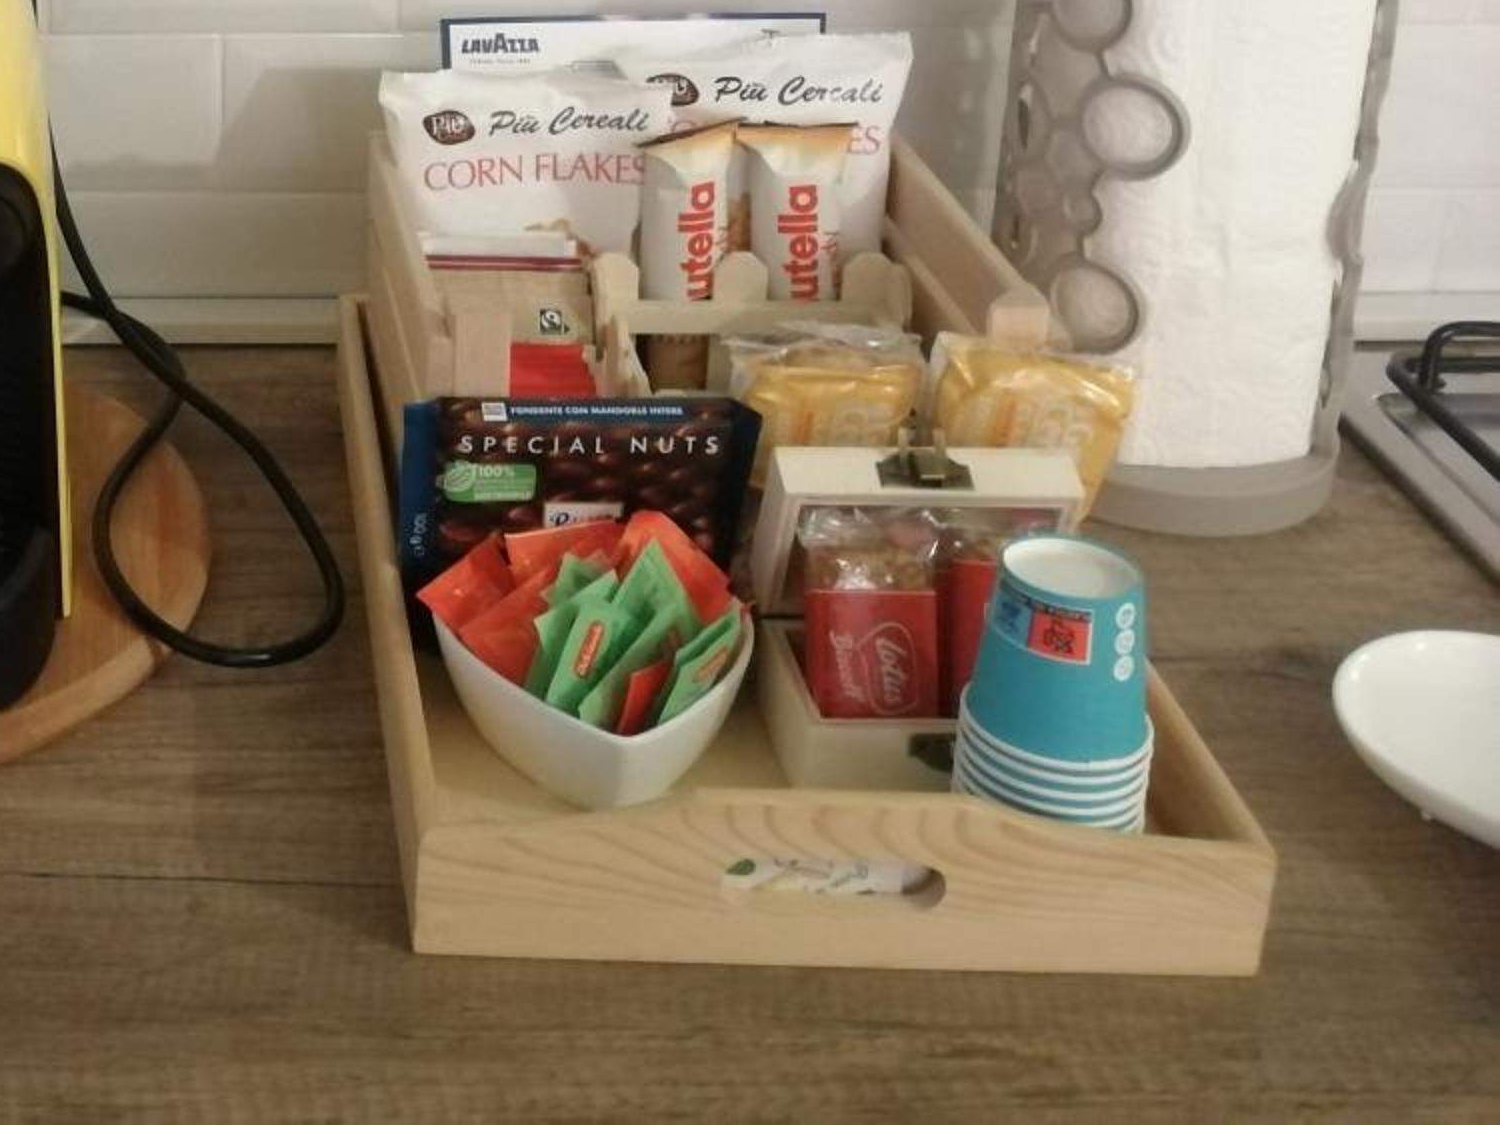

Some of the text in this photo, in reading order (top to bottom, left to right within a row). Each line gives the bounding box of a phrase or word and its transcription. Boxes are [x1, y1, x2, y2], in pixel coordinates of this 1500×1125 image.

[461, 32, 540, 55] LAVAZZA
[777, 74, 885, 106] Cereali
[548, 105, 650, 136] Cereali
[423, 154, 524, 192] CORN
[676, 180, 715, 301] utella
[776, 184, 820, 301] utella
[457, 435, 721, 456] SPECIAL NUTS
